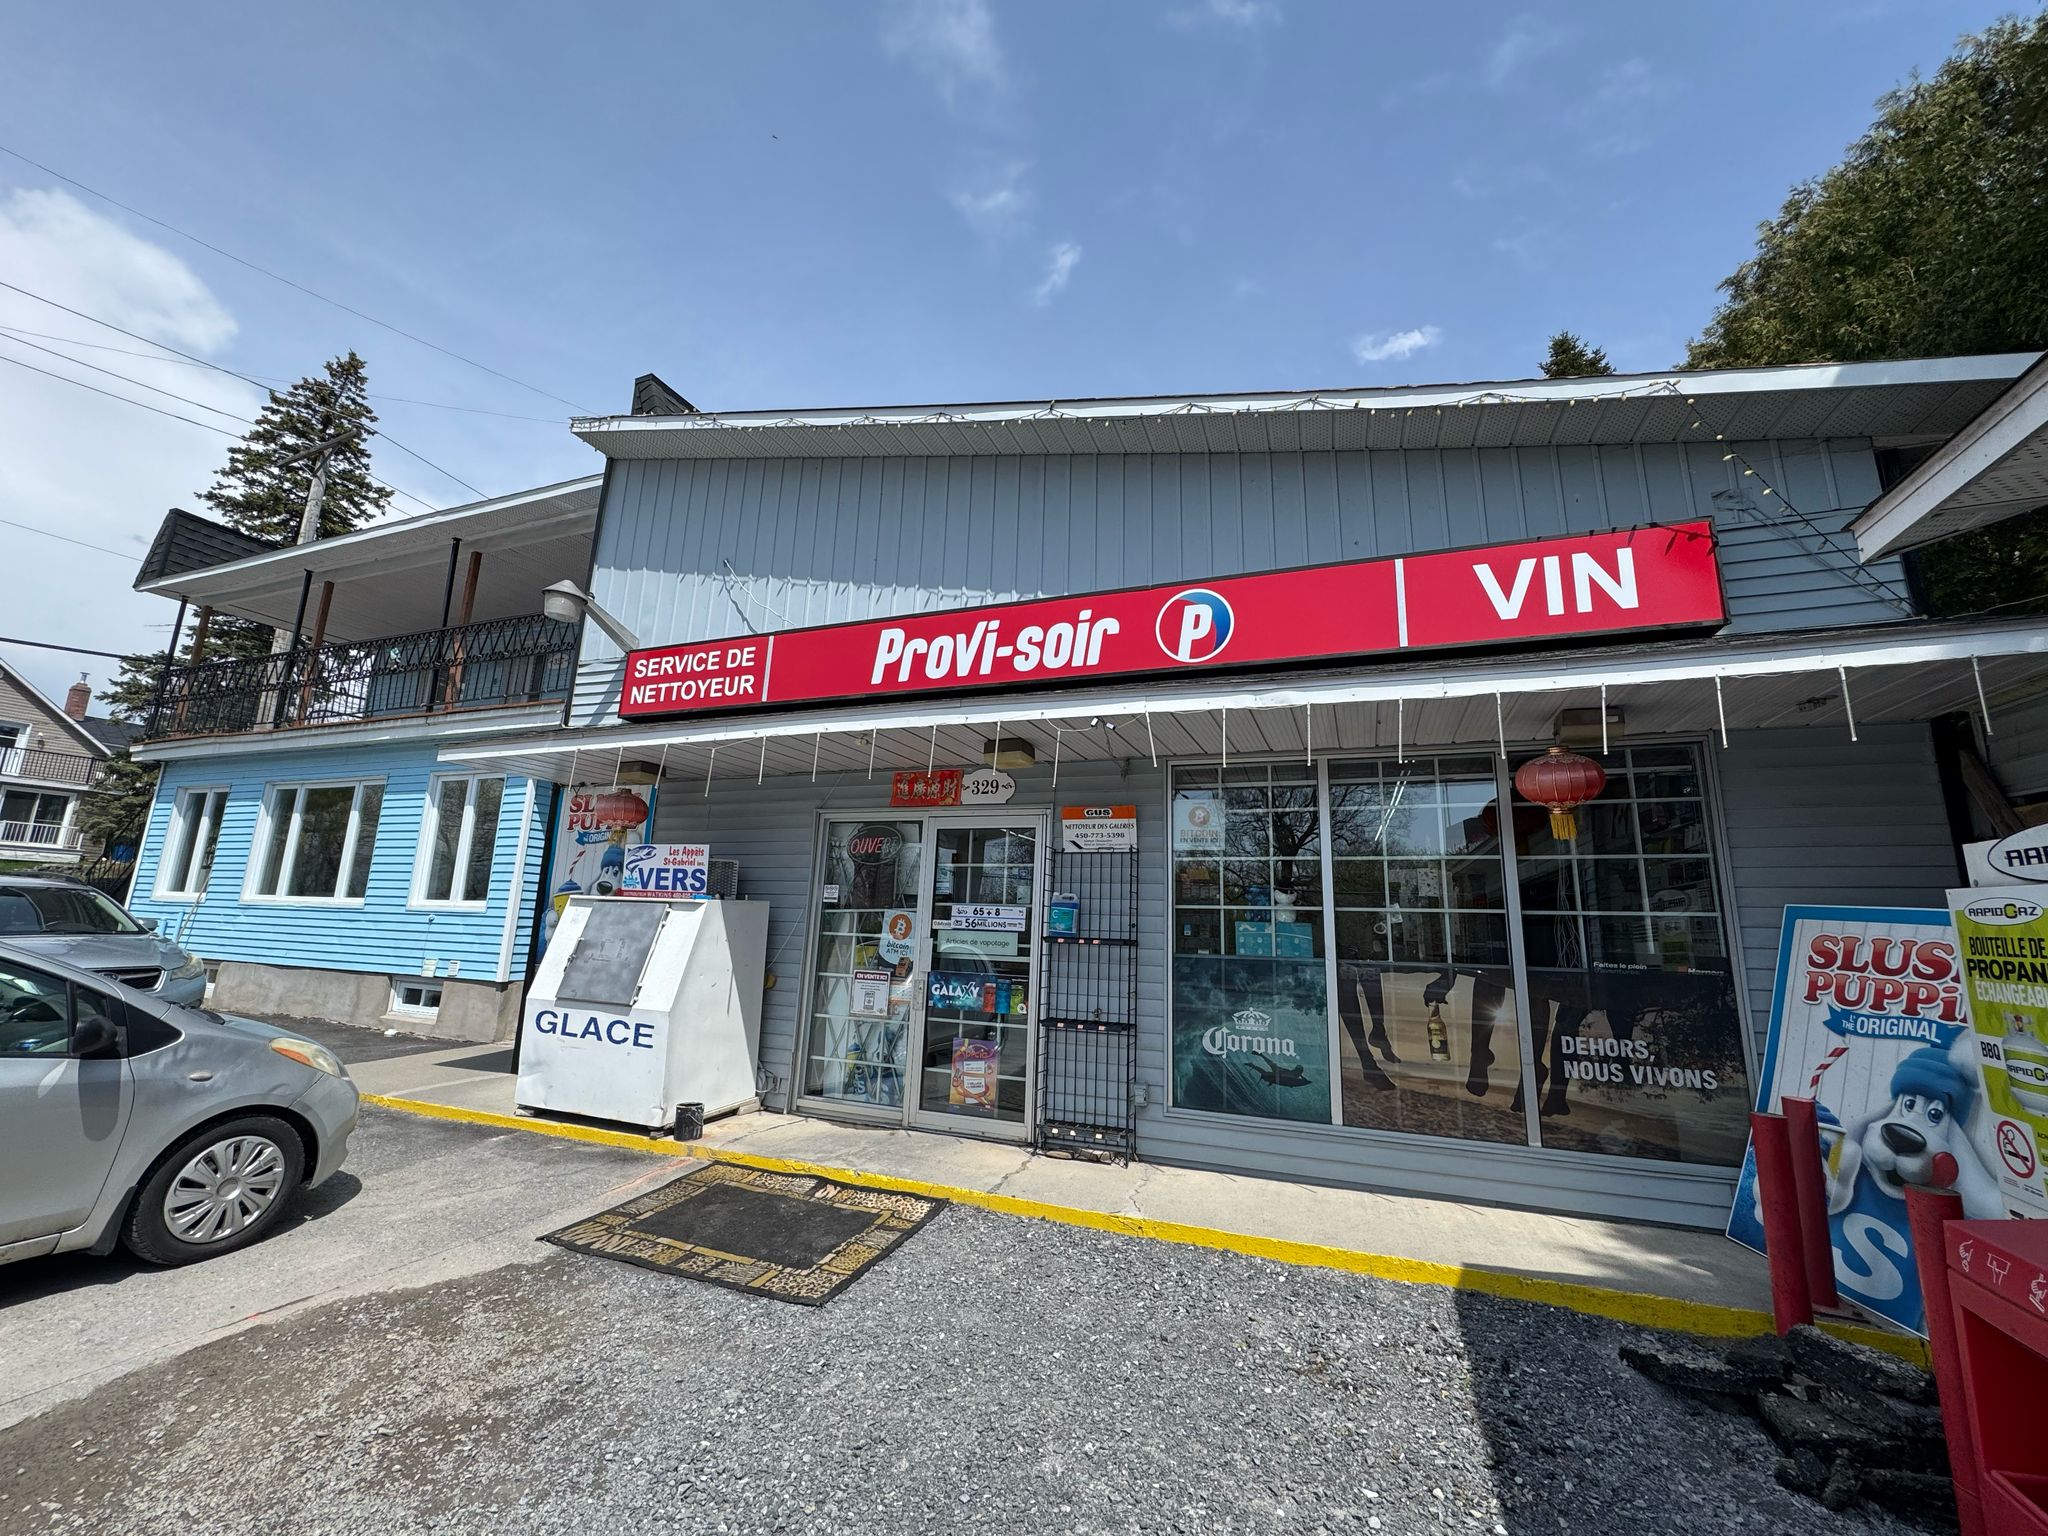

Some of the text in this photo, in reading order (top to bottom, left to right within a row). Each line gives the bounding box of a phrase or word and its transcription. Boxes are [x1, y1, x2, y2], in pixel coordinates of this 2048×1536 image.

[1472, 547, 1639, 621] VIN
[634, 647, 757, 679] SERVICE DE
[630, 674, 756, 706] NETTOYEUR
[971, 779, 999, 795] 329
[1109, 822, 1135, 830] GALERIES
[1180, 829, 1218, 838] BITCOIN
[669, 846, 679, 856] Les
[663, 857, 696, 867] St-Gabriel
[638, 867, 706, 892] VERS
[972, 906, 985, 916] 65
[994, 907, 1001, 917] 8
[1968, 903, 2039, 919] RAPIDGAZ
[965, 918, 977, 929] 56
[976, 920, 1007, 929] MILLIONS
[885, 947, 908, 957] ATM ICI
[886, 939, 910, 950] bitcoin
[945, 937, 1010, 948] Articles de vapotage
[1969, 936, 2048, 960] BOUTEILLE DE
[1593, 961, 1648, 971] Faites le plein
[1807, 933, 1961, 984] SLUS
[1966, 957, 2048, 984] PROPAN
[931, 981, 980, 1000] GALAXY
[535, 1010, 656, 1050] GLACE
[1856, 1016, 1942, 1044] ORIGINAL
[1202, 1026, 1297, 1059] Corona
[1560, 1035, 1656, 1062] DEHORS,
[1980, 1041, 2002, 1062] BBQ
[1563, 1060, 1719, 1091] NOUS VIVONS
